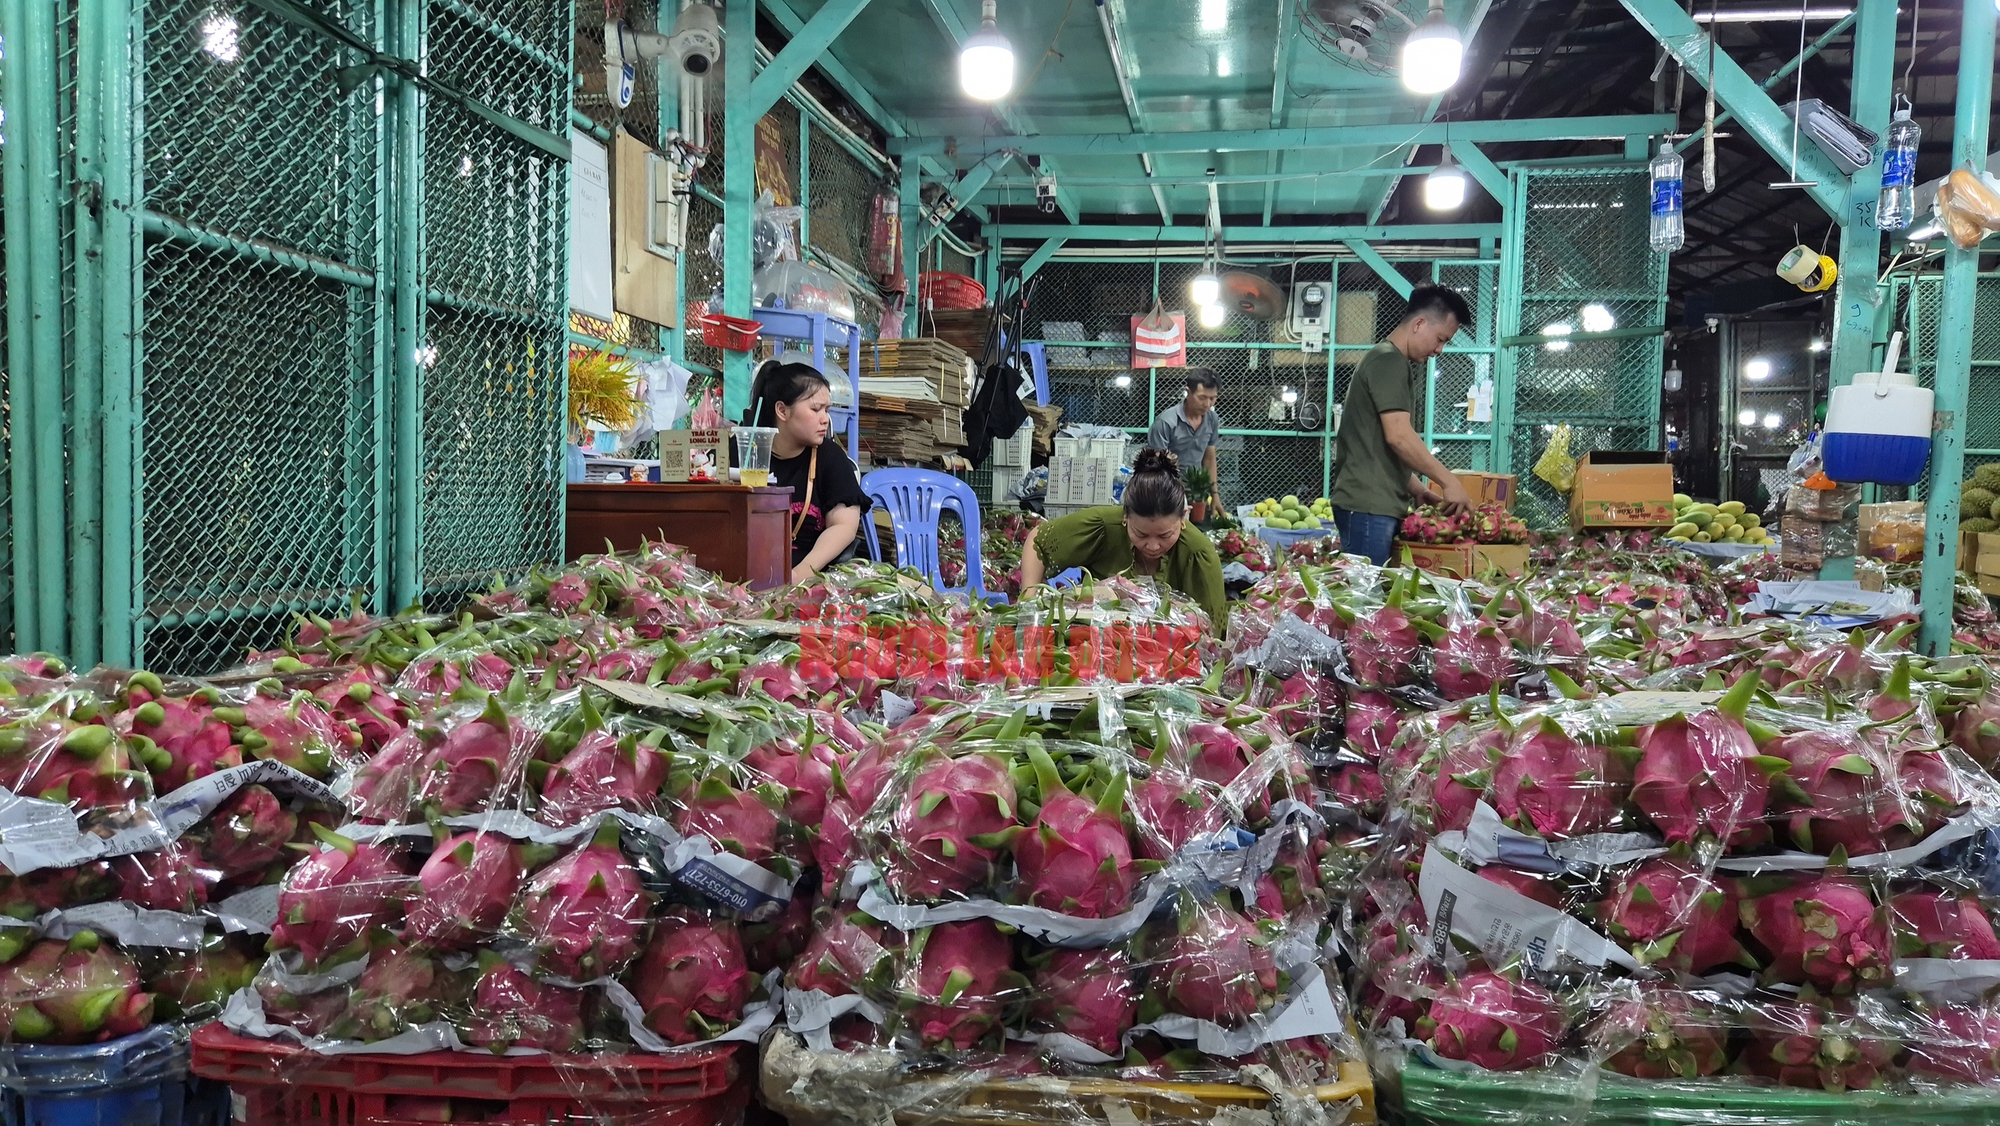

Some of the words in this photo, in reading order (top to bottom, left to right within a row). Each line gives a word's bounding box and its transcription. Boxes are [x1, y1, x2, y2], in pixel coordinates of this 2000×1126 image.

[1855, 201, 1875, 215] 35
[1850, 303, 1862, 318] 9
[708, 436, 721, 444] LÂM
